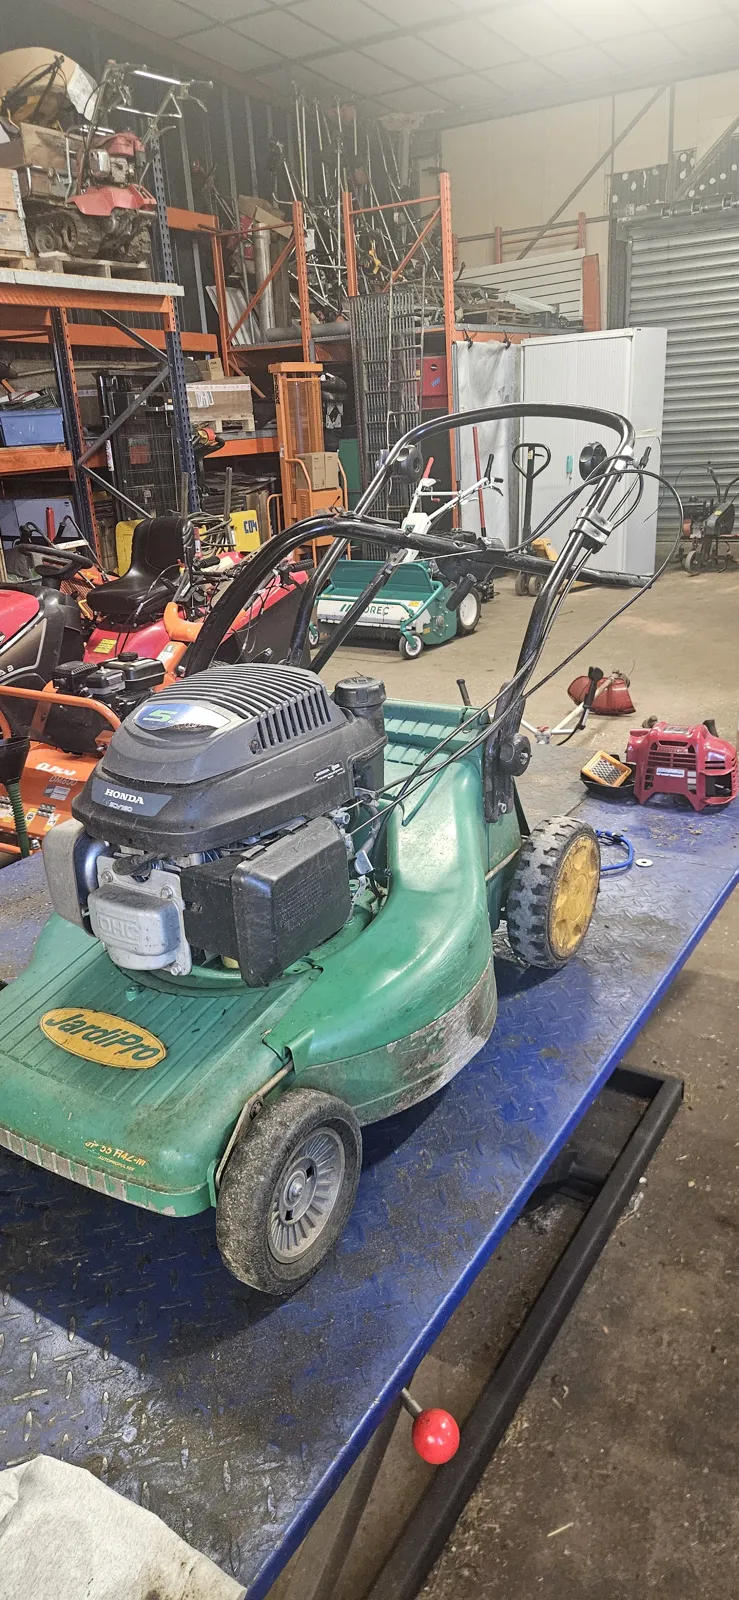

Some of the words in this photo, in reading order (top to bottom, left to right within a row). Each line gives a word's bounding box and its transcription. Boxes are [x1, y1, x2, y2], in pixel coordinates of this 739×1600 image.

[104, 788, 145, 805] HONDA
[98, 916, 141, 941] OHC
[45, 1013, 161, 1061] JardiPro
